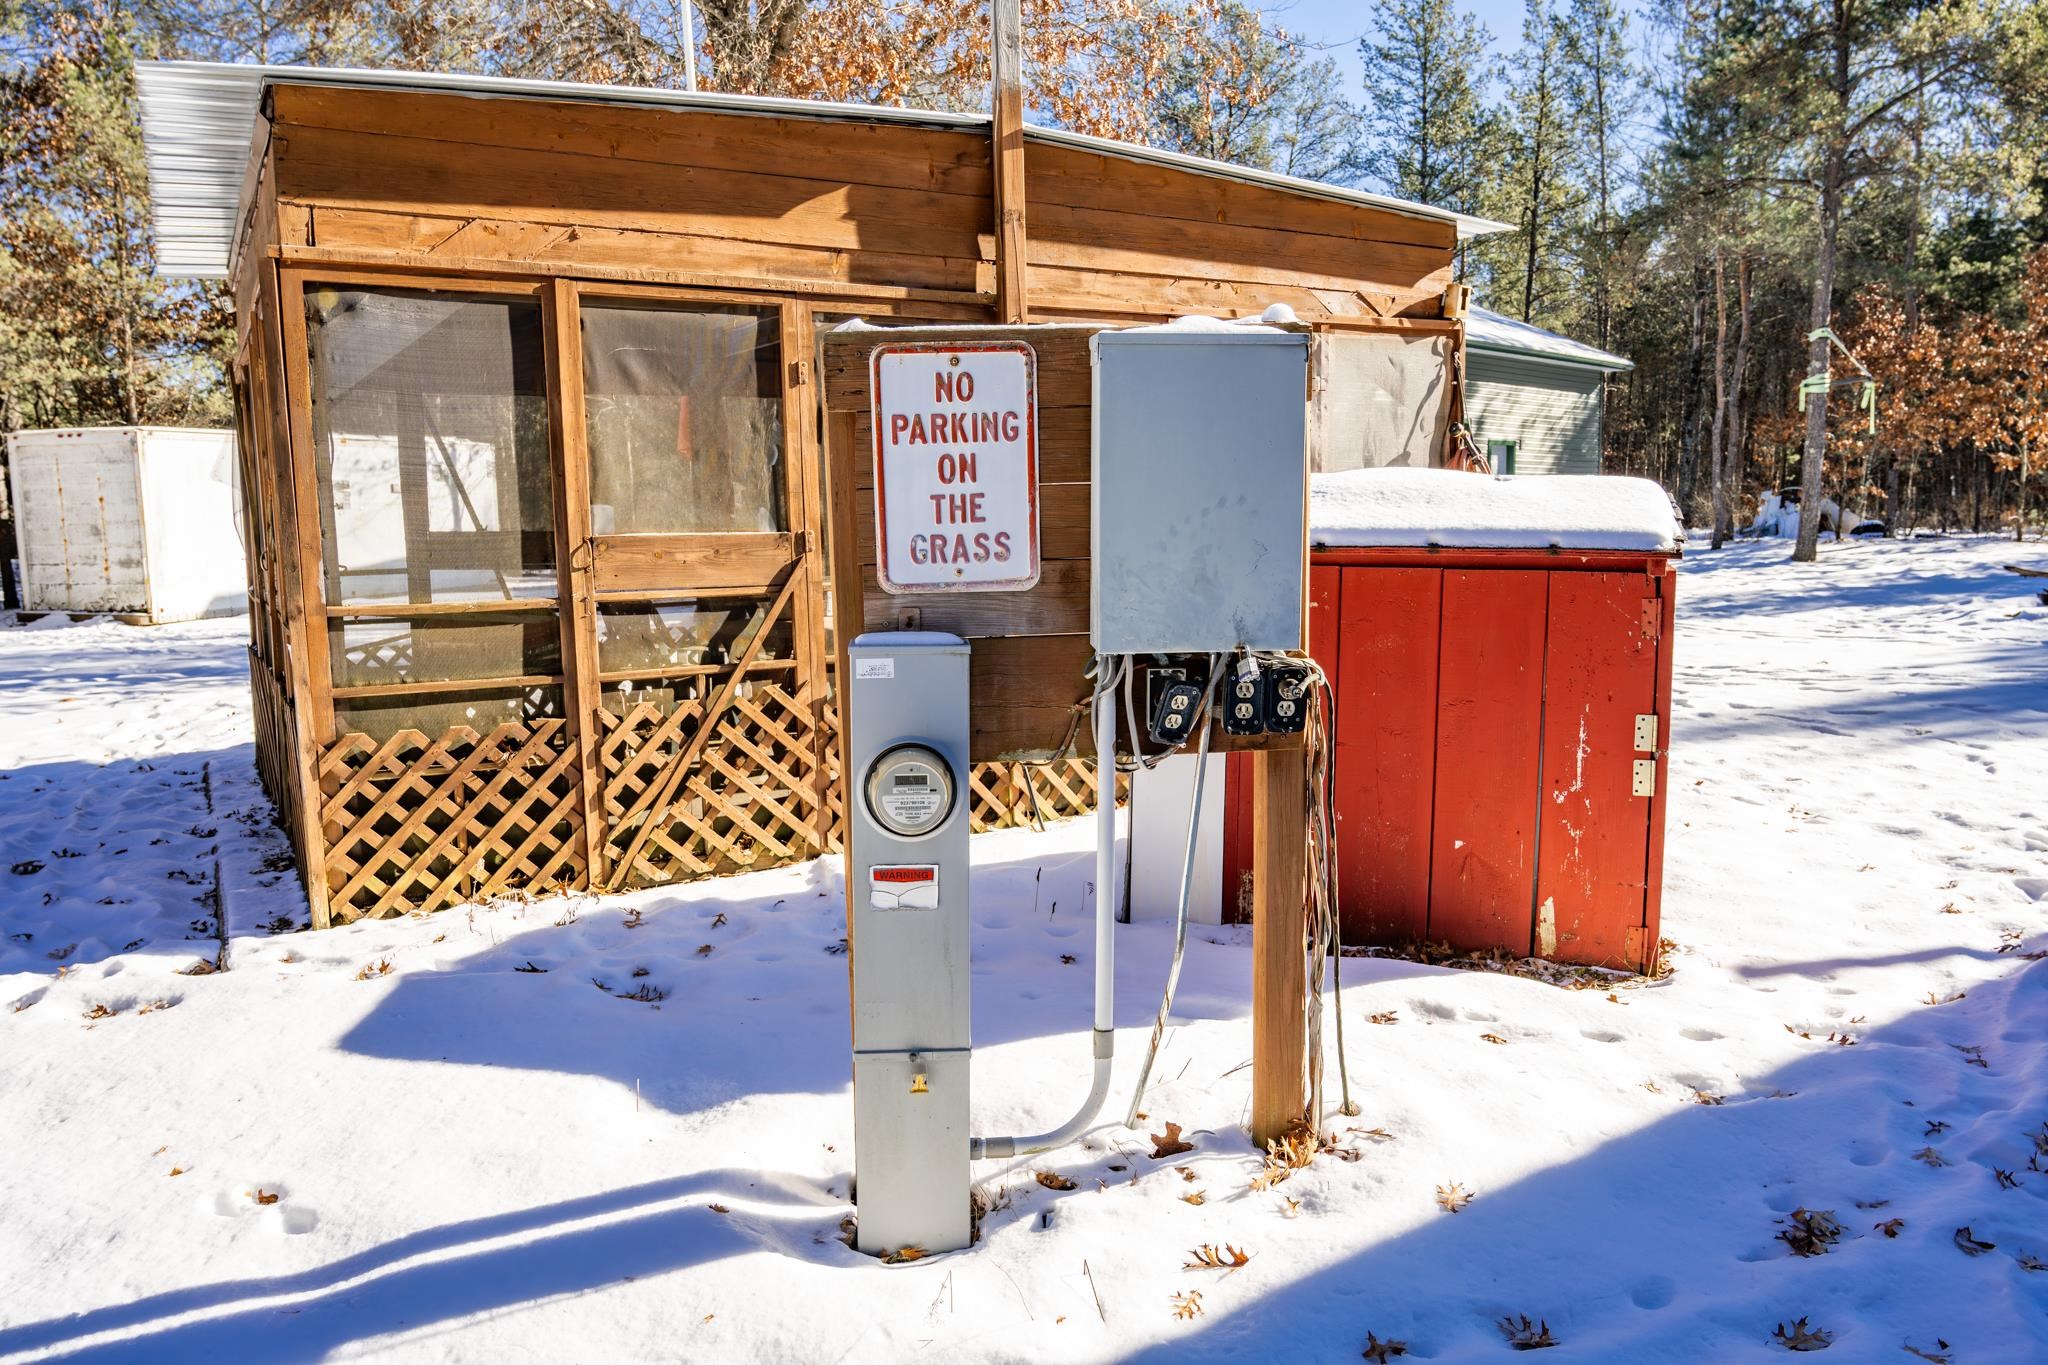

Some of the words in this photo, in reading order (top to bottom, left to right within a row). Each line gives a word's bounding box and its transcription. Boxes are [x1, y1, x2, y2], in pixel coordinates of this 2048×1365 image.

[935, 371, 974, 403] NO
[891, 411, 1020, 446] PARKING
[937, 453, 977, 485] ON
[930, 492, 986, 525] THE
[910, 531, 1011, 565] GRASS
[879, 871, 929, 880] WARNING
